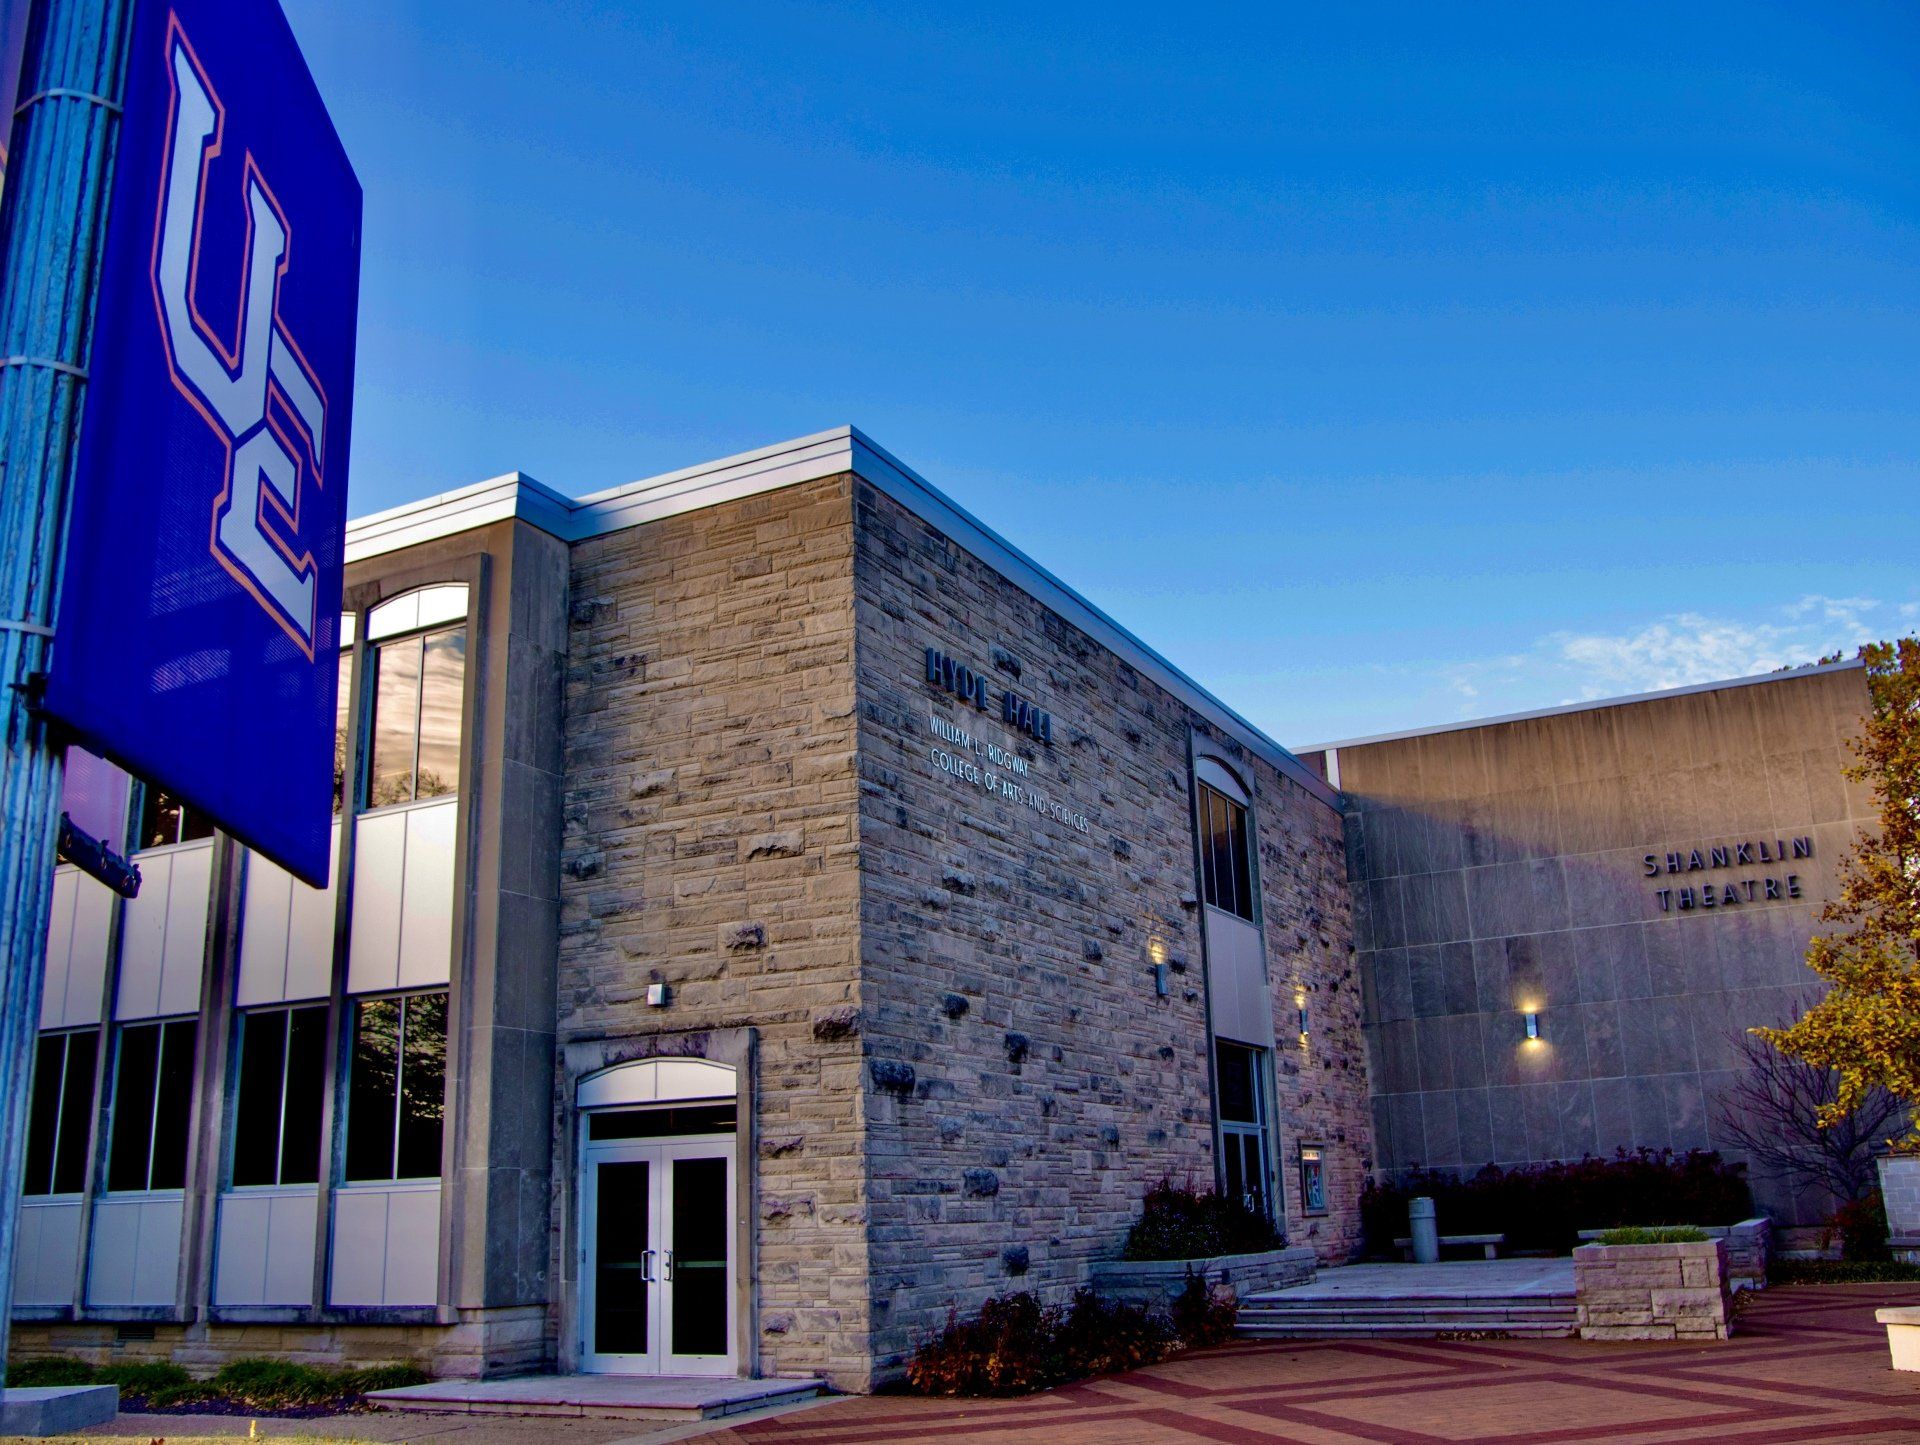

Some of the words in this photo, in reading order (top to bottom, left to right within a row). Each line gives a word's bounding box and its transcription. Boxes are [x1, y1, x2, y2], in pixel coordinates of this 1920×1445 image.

[925, 647, 988, 711] HYDE
[1002, 691, 1055, 747] HALL
[930, 715, 970, 750] WILLIAM
[975, 738, 984, 757] L.
[988, 744, 1028, 778] RIDGWAY
[931, 748, 979, 785] COLLEGE
[984, 772, 998, 792] OF
[1002, 781, 1024, 804] ARTS
[1028, 793, 1046, 814] AND
[1050, 802, 1089, 834] SCIENCES
[1643, 836, 1811, 877] SHANKLIN
[1656, 873, 1801, 912] THEATRE
